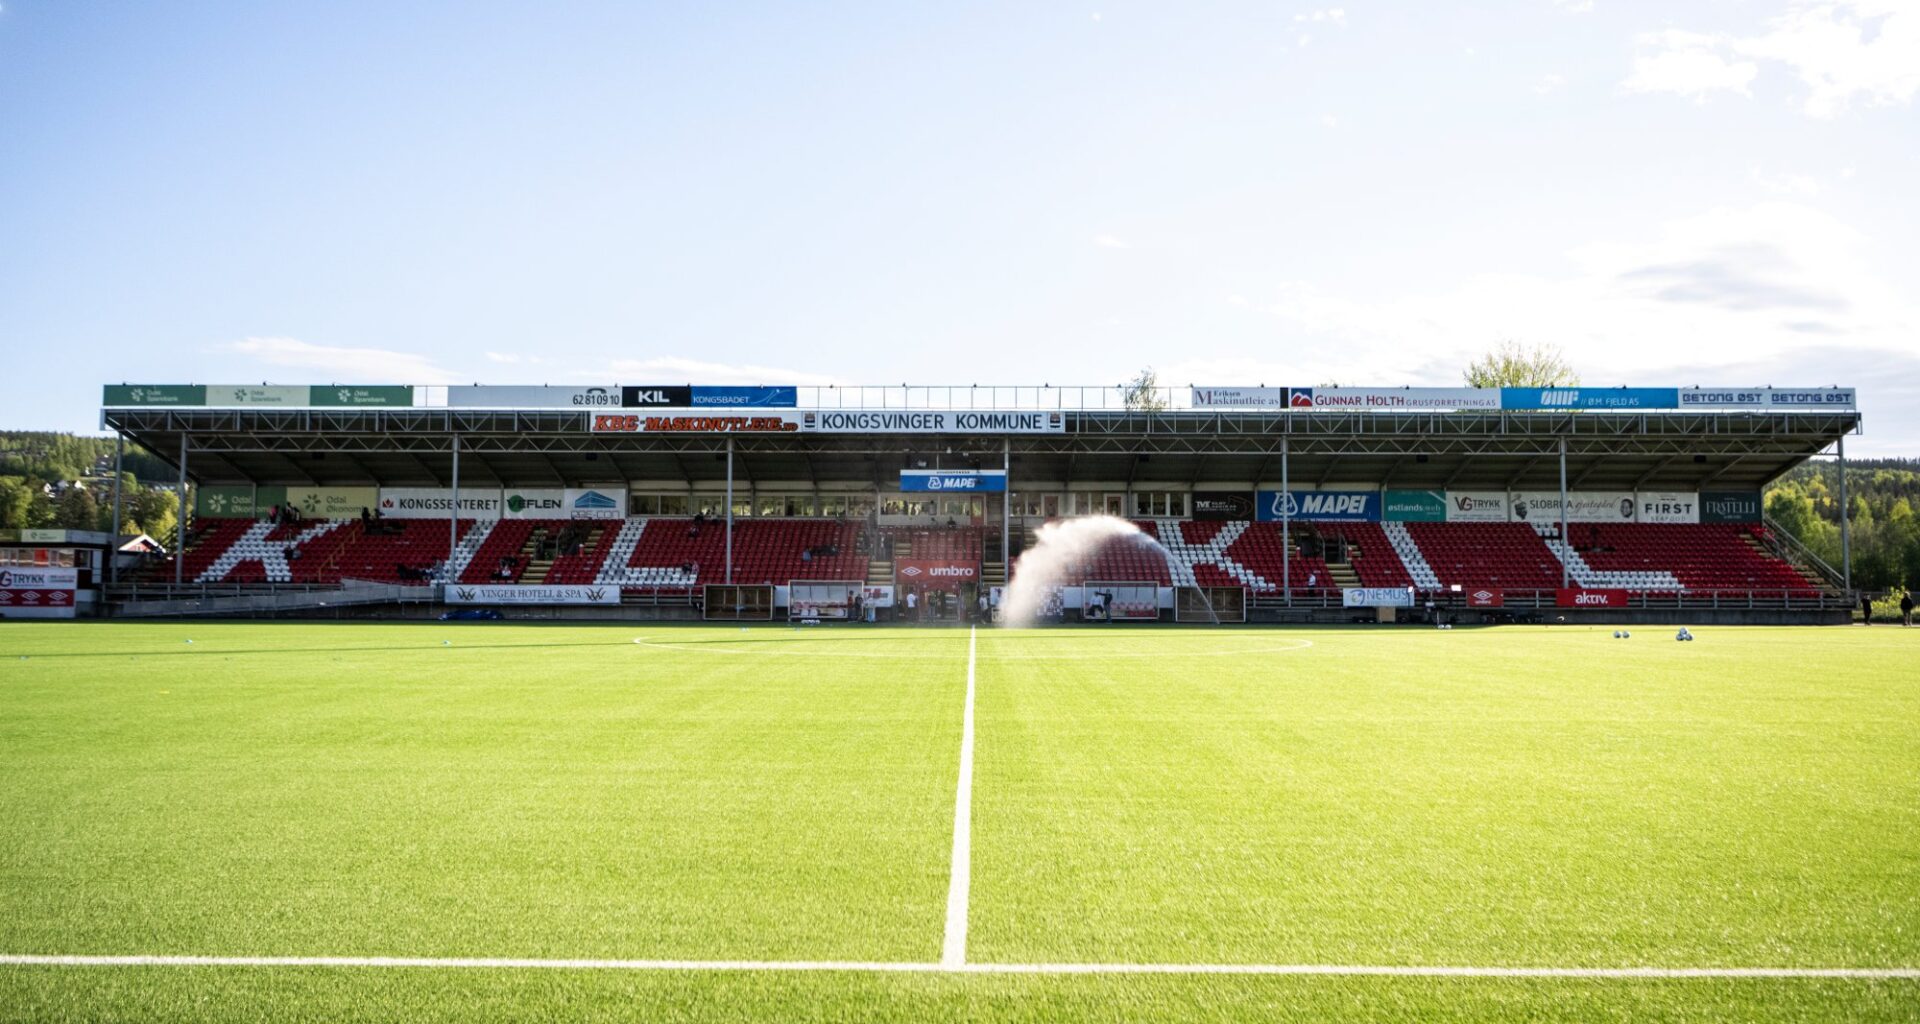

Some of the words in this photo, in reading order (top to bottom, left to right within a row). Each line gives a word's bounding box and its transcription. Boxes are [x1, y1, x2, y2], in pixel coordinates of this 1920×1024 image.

[638, 390, 670, 403] KIL
[693, 396, 750, 404] KONGSBADET
[1315, 395, 1362, 406] GUNNAR
[1366, 395, 1405, 406] HOLTH
[1682, 393, 1734, 402] BETONG
[1737, 393, 1762, 402] ØST
[1771, 393, 1822, 402] BETONG
[1826, 393, 1850, 402] ØST
[822, 413, 944, 430] KONGSVINGER
[956, 413, 1043, 430] KOMMUNE
[399, 498, 499, 510] KONGSSENTERET
[506, 498, 562, 510] VEFLEN
[1301, 494, 1367, 514] MAPEI
[1473, 499, 1501, 508] TRYKK
[1530, 499, 1573, 509] SLOBRA
[1645, 503, 1692, 514] FIRST
[1706, 501, 1756, 515] FRATELLI
[929, 565, 974, 576] umbro
[480, 589, 516, 598] VINGER
[518, 589, 553, 598] HOTELL
[565, 589, 582, 598] SPA
[1366, 589, 1408, 600] NEMUS
